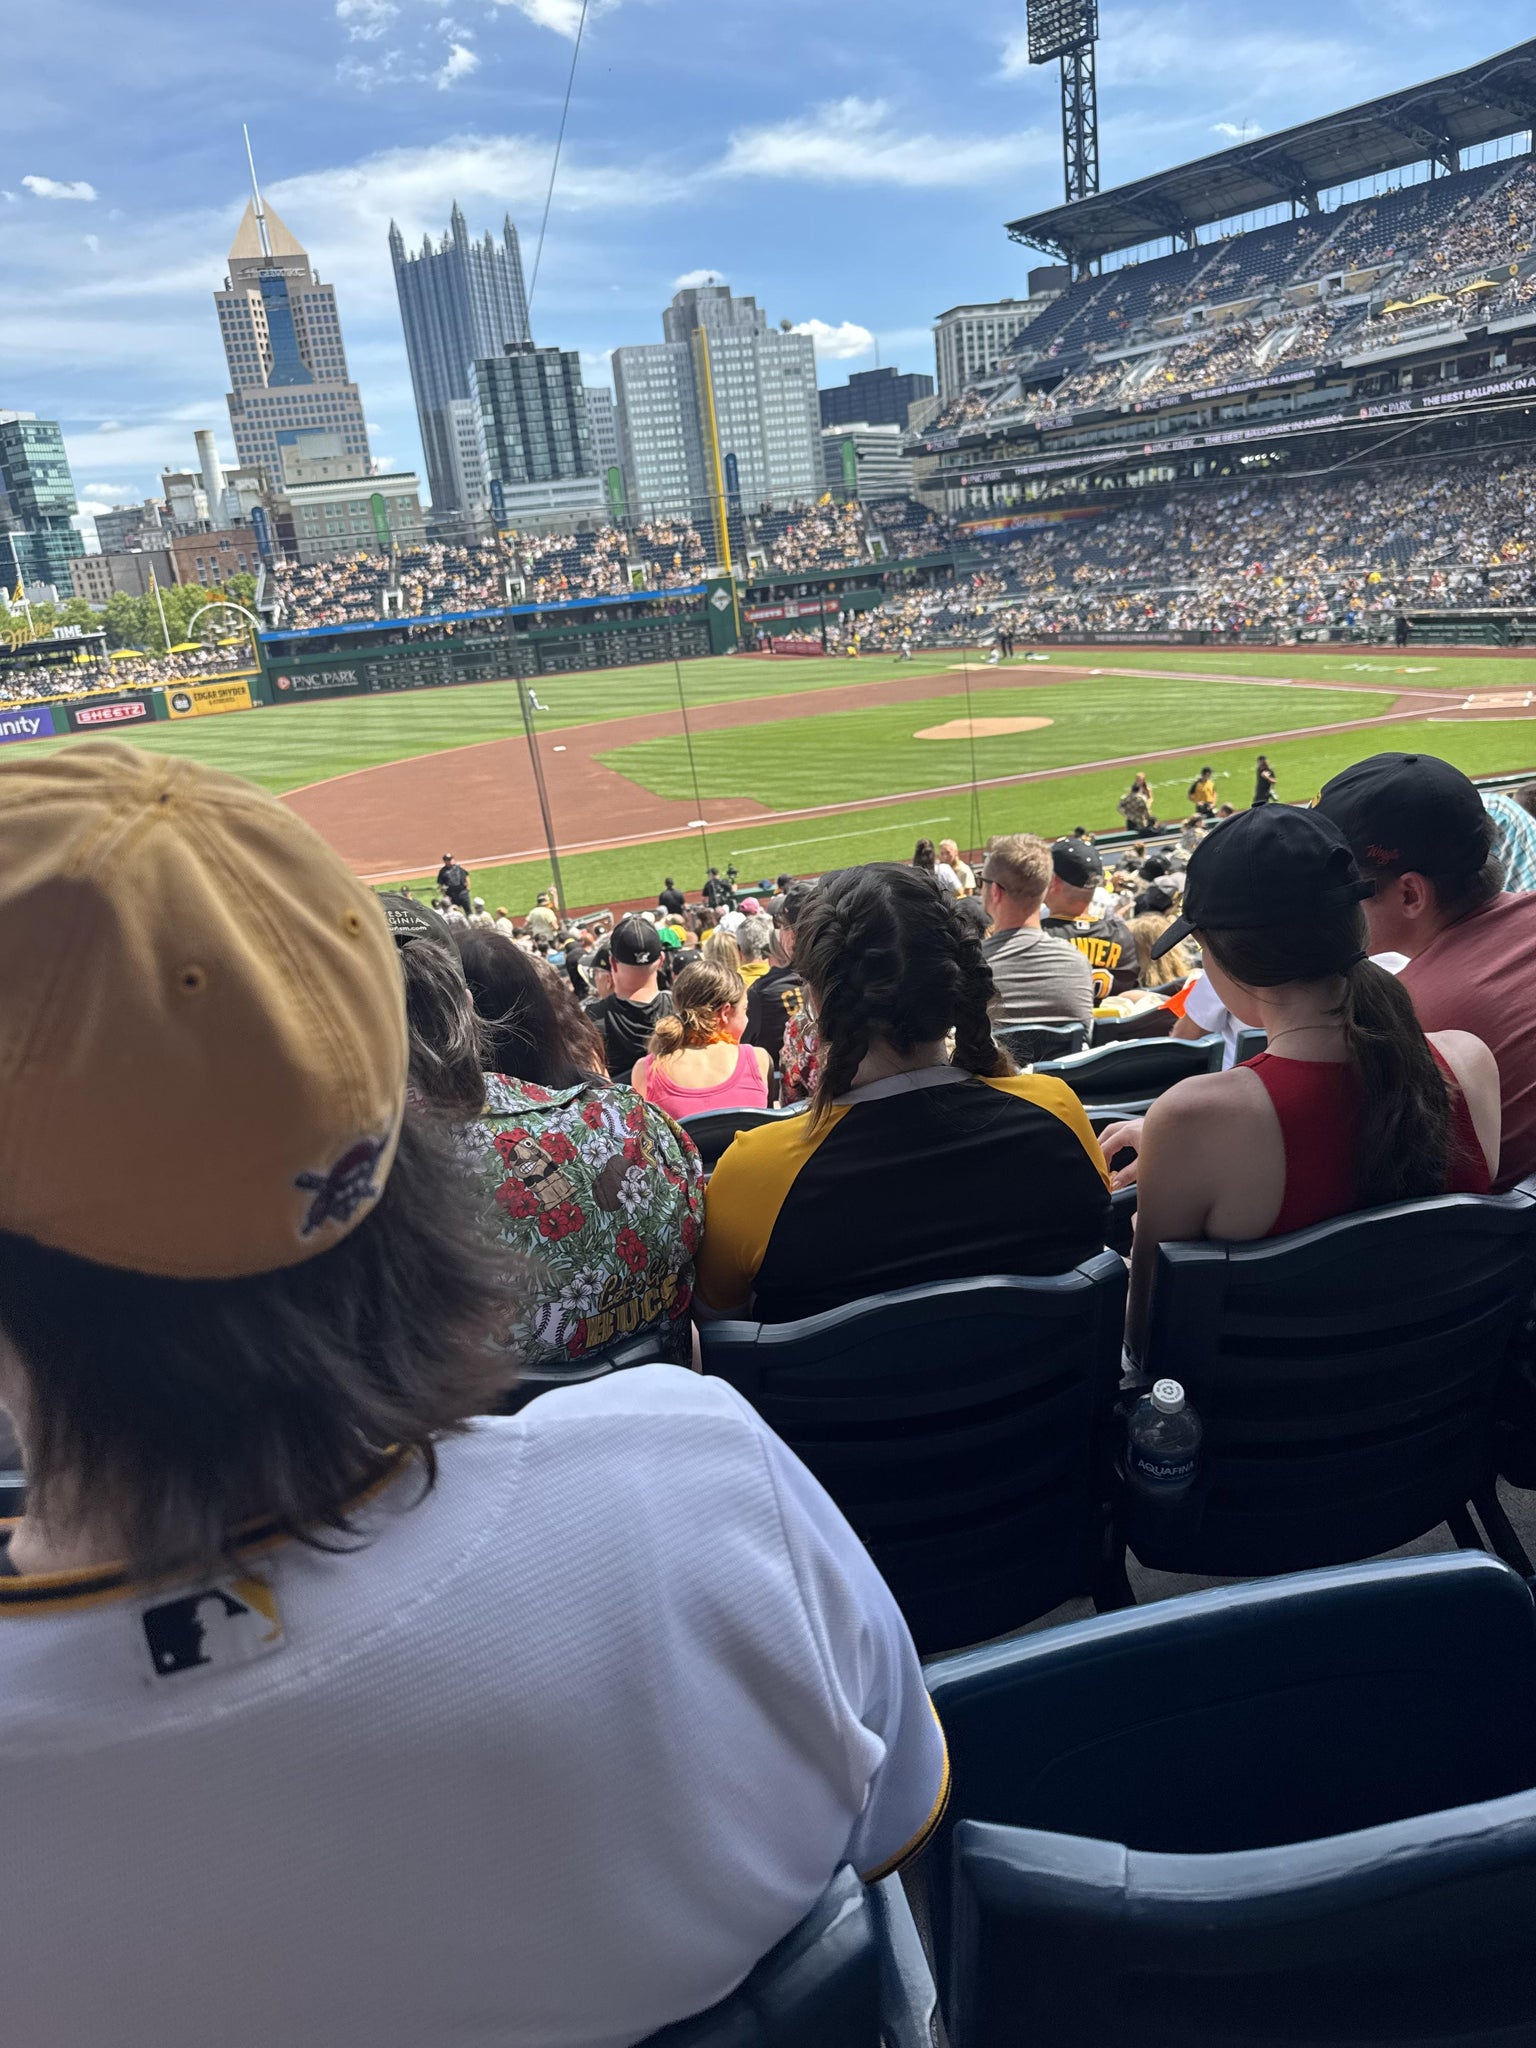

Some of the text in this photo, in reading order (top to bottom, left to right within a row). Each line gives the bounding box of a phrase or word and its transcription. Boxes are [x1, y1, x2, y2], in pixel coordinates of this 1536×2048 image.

[1369, 404, 1388, 416] PNC
[1389, 400, 1412, 413] PARK
[1422, 394, 1440, 406] THE
[1441, 391, 1464, 404] BEST
[1465, 382, 1514, 399] BALLPARK
[1515, 378, 1527, 389] IN
[52, 624, 83, 639] TIME
[290, 674, 319, 688] PNC
[321, 670, 356, 684] PARK
[81, 704, 142, 722] SHEETZ
[386, 910, 409, 918] EST
[387, 917, 430, 927] GINIA
